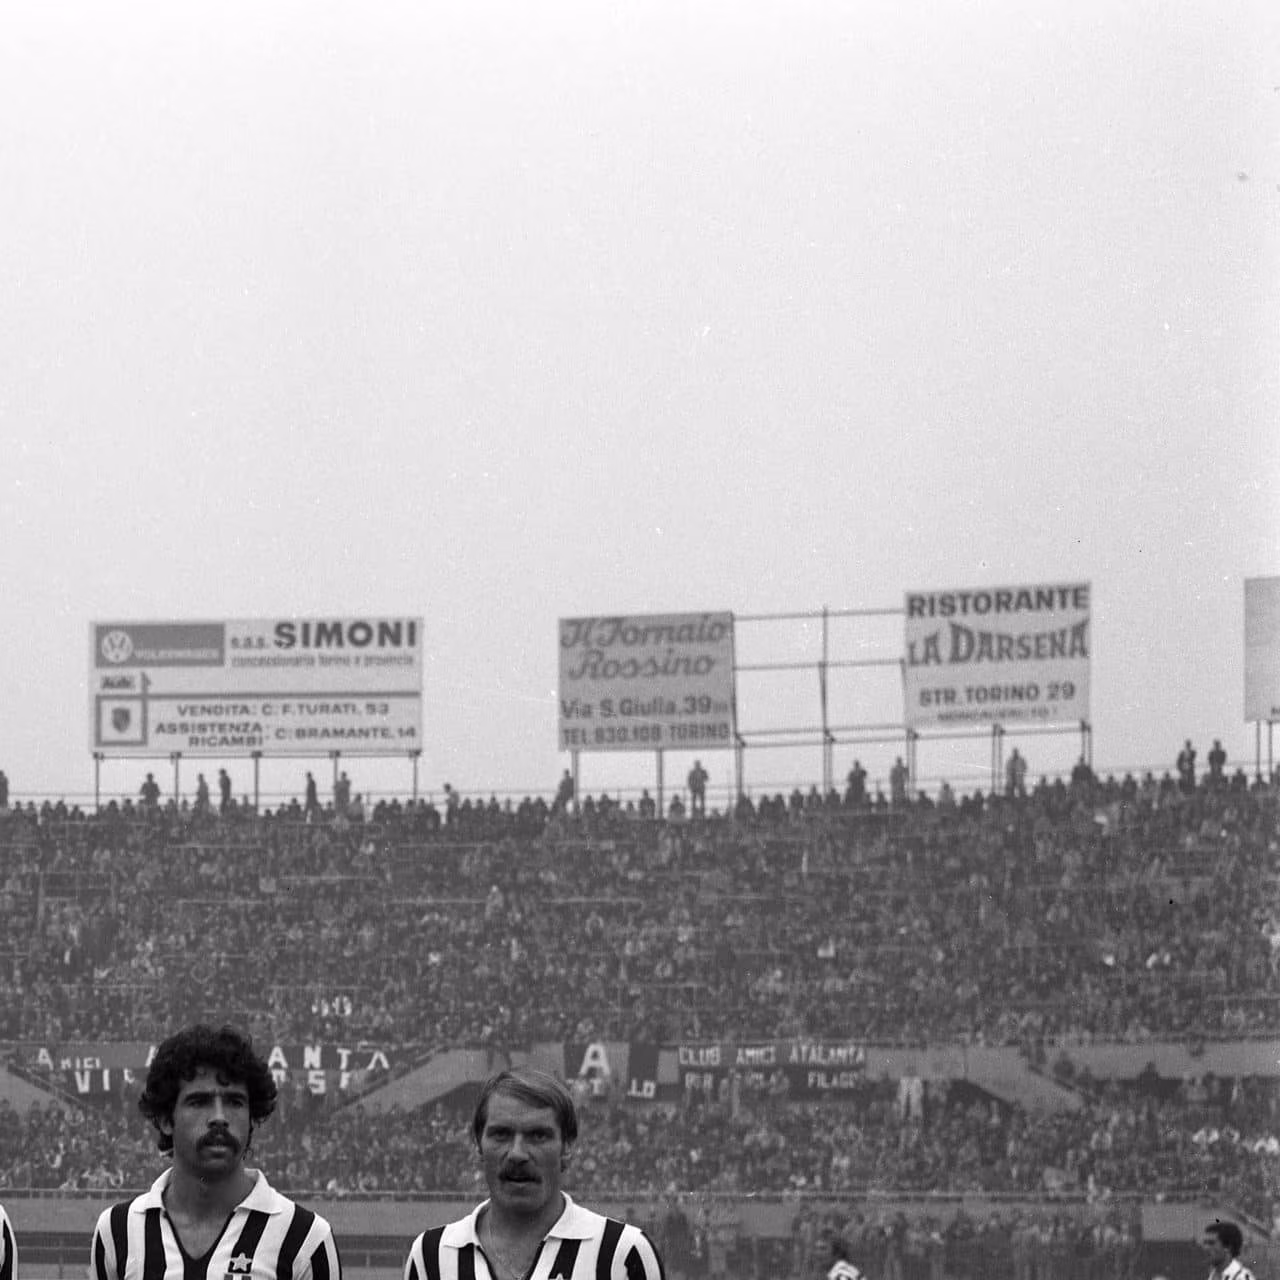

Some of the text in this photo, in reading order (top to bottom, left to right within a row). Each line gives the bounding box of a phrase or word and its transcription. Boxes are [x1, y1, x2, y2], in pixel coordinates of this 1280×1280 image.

[907, 586, 1090, 618] RISTORANTE
[274, 620, 417, 650] SIMONI
[907, 617, 1091, 667] LA DARSENA
[679, 1045, 721, 1066] CLUB
